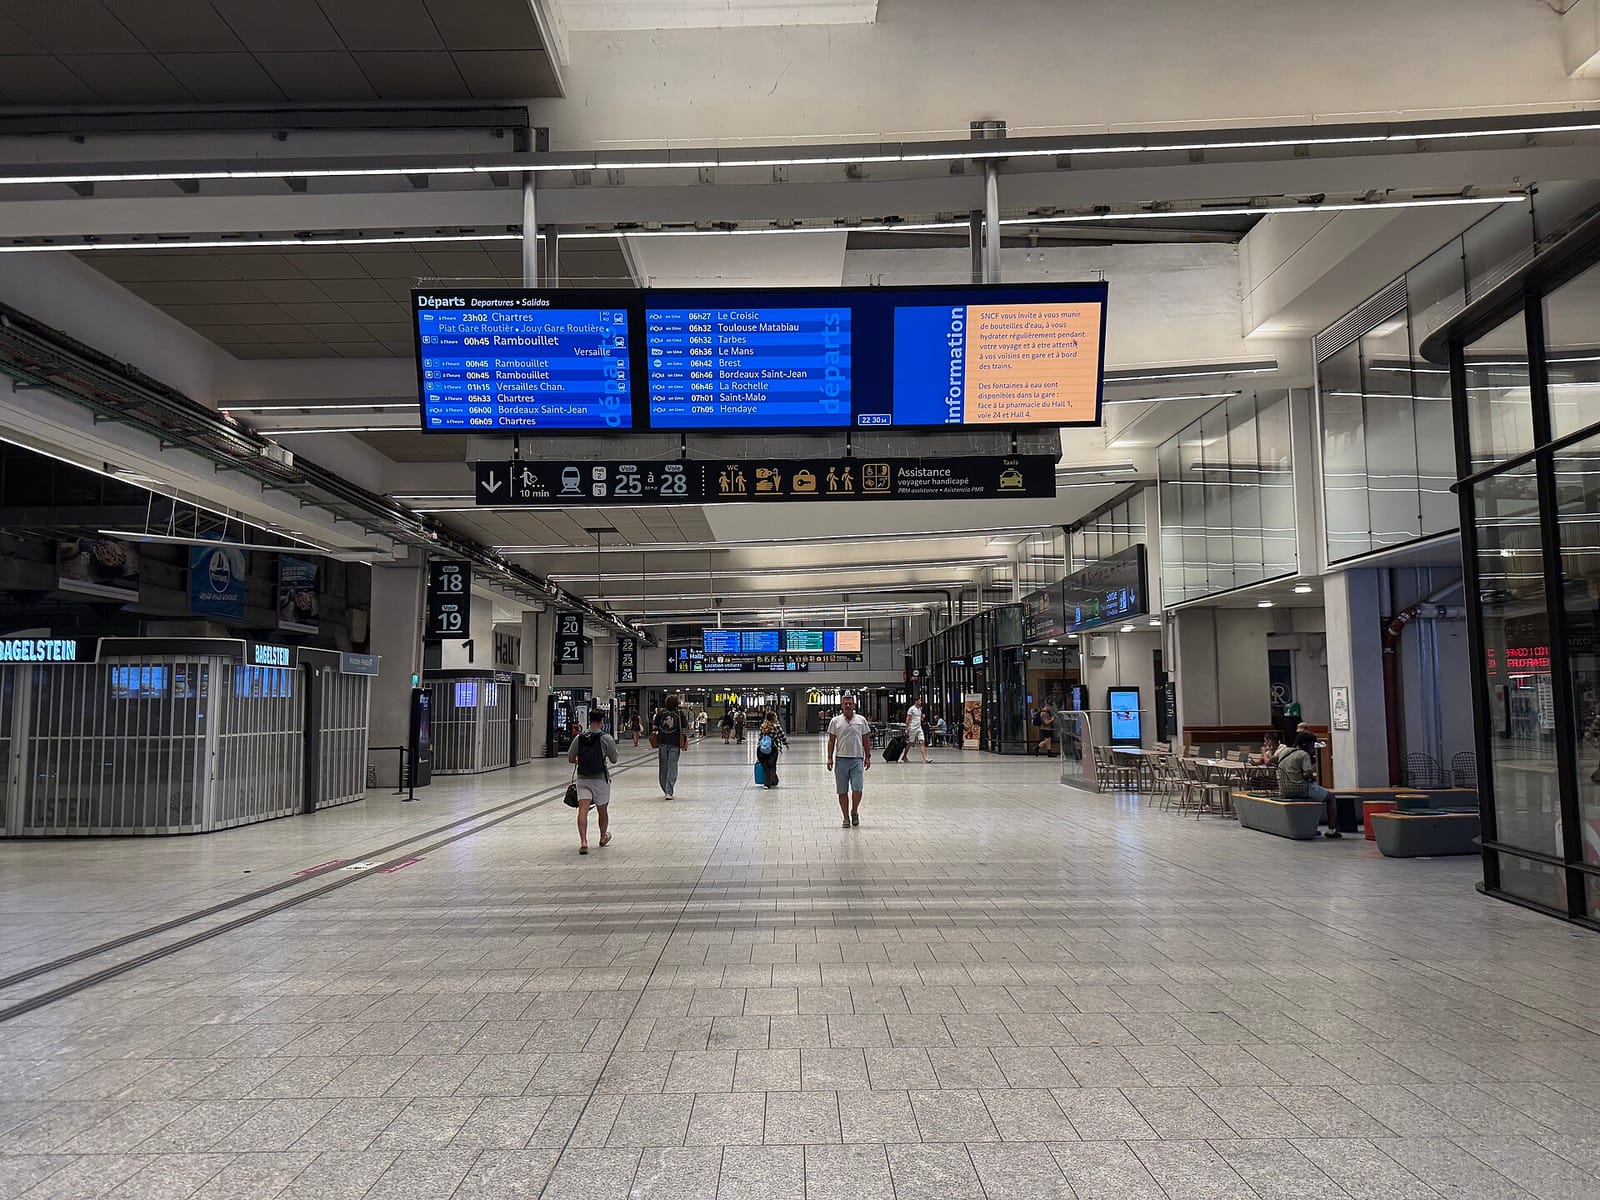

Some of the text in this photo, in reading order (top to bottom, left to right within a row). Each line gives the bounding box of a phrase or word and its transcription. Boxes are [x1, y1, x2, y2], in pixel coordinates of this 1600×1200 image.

[418, 295, 550, 309] Départs Departures Salidas
[462, 314, 488, 322] 23h02
[492, 312, 534, 322] Chartres
[688, 311, 759, 320] 06h27 Le Croisic
[980, 312, 999, 320] SNCF
[1018, 311, 1037, 319] invite
[457, 324, 480, 333] Gare
[520, 323, 543, 334] Jouy
[544, 324, 565, 332] Gare
[717, 323, 758, 332] Toulouse
[759, 322, 800, 332] Matabiau
[980, 322, 989, 330] de
[990, 322, 1023, 330] bouteilles
[1024, 321, 1044, 330] d'eau,
[1045, 321, 1050, 329] à
[464, 335, 559, 346] 00h45 Rambouillet
[718, 335, 747, 344] Tarbes
[979, 332, 1008, 341] hydrater
[1057, 331, 1085, 339] pendant
[998, 343, 1022, 351] voyage
[1031, 341, 1036, 349] à
[718, 347, 730, 356] Le
[731, 347, 754, 356] Mans
[1031, 352, 1047, 360] gare
[1056, 350, 1060, 358] à
[1061, 350, 1077, 358] bord
[465, 359, 549, 369] 00h45 Rambouillet
[690, 359, 742, 367] 06h42 Brest
[819, 312, 846, 414] départs
[944, 306, 964, 424] information
[992, 362, 1013, 370] trains.
[466, 370, 550, 380] 00h45 Rambouillet
[719, 370, 760, 379] Bordeaux
[761, 370, 808, 379] Saint-Jean
[467, 382, 565, 391] 01h15 Versailles Chan.
[719, 382, 730, 390] La
[731, 381, 769, 390] Rochelle
[978, 382, 991, 390] Des
[468, 394, 535, 403] 05h33 Chartres
[691, 393, 767, 402] 07h01 Saint-Malo
[978, 392, 1015, 400] disponibles
[1016, 391, 1032, 399] dans
[1041, 392, 1056, 400] gare
[720, 404, 758, 415] Hendaye
[992, 401, 997, 409] à
[998, 401, 1005, 409] la
[1006, 400, 1040, 409] pharmacie
[1041, 400, 1050, 408] du
[1051, 400, 1065, 408] Hall
[498, 405, 539, 415] Bordeaux
[541, 405, 588, 415] Saint-Jean
[992, 411, 1001, 419] 24
[499, 417, 536, 427] Chartres
[897, 467, 951, 477] Assistance
[614, 471, 654, 494] 25 à
[660, 474, 687, 493] 28
[897, 477, 969, 487] voyageur handicapé
[519, 489, 550, 498] 10 min
[439, 574, 463, 591] 18
[438, 612, 462, 630] 19
[562, 621, 578, 633] 20
[0, 640, 77, 661] BAGELSTEIN
[495, 632, 520, 666] Hall 1
[622, 642, 633, 650] 22
[255, 644, 290, 666] BAGELSTEIN
[461, 639, 474, 664] 1
[563, 646, 578, 658] 21
[622, 656, 633, 665] 23
[622, 672, 633, 680] 24
